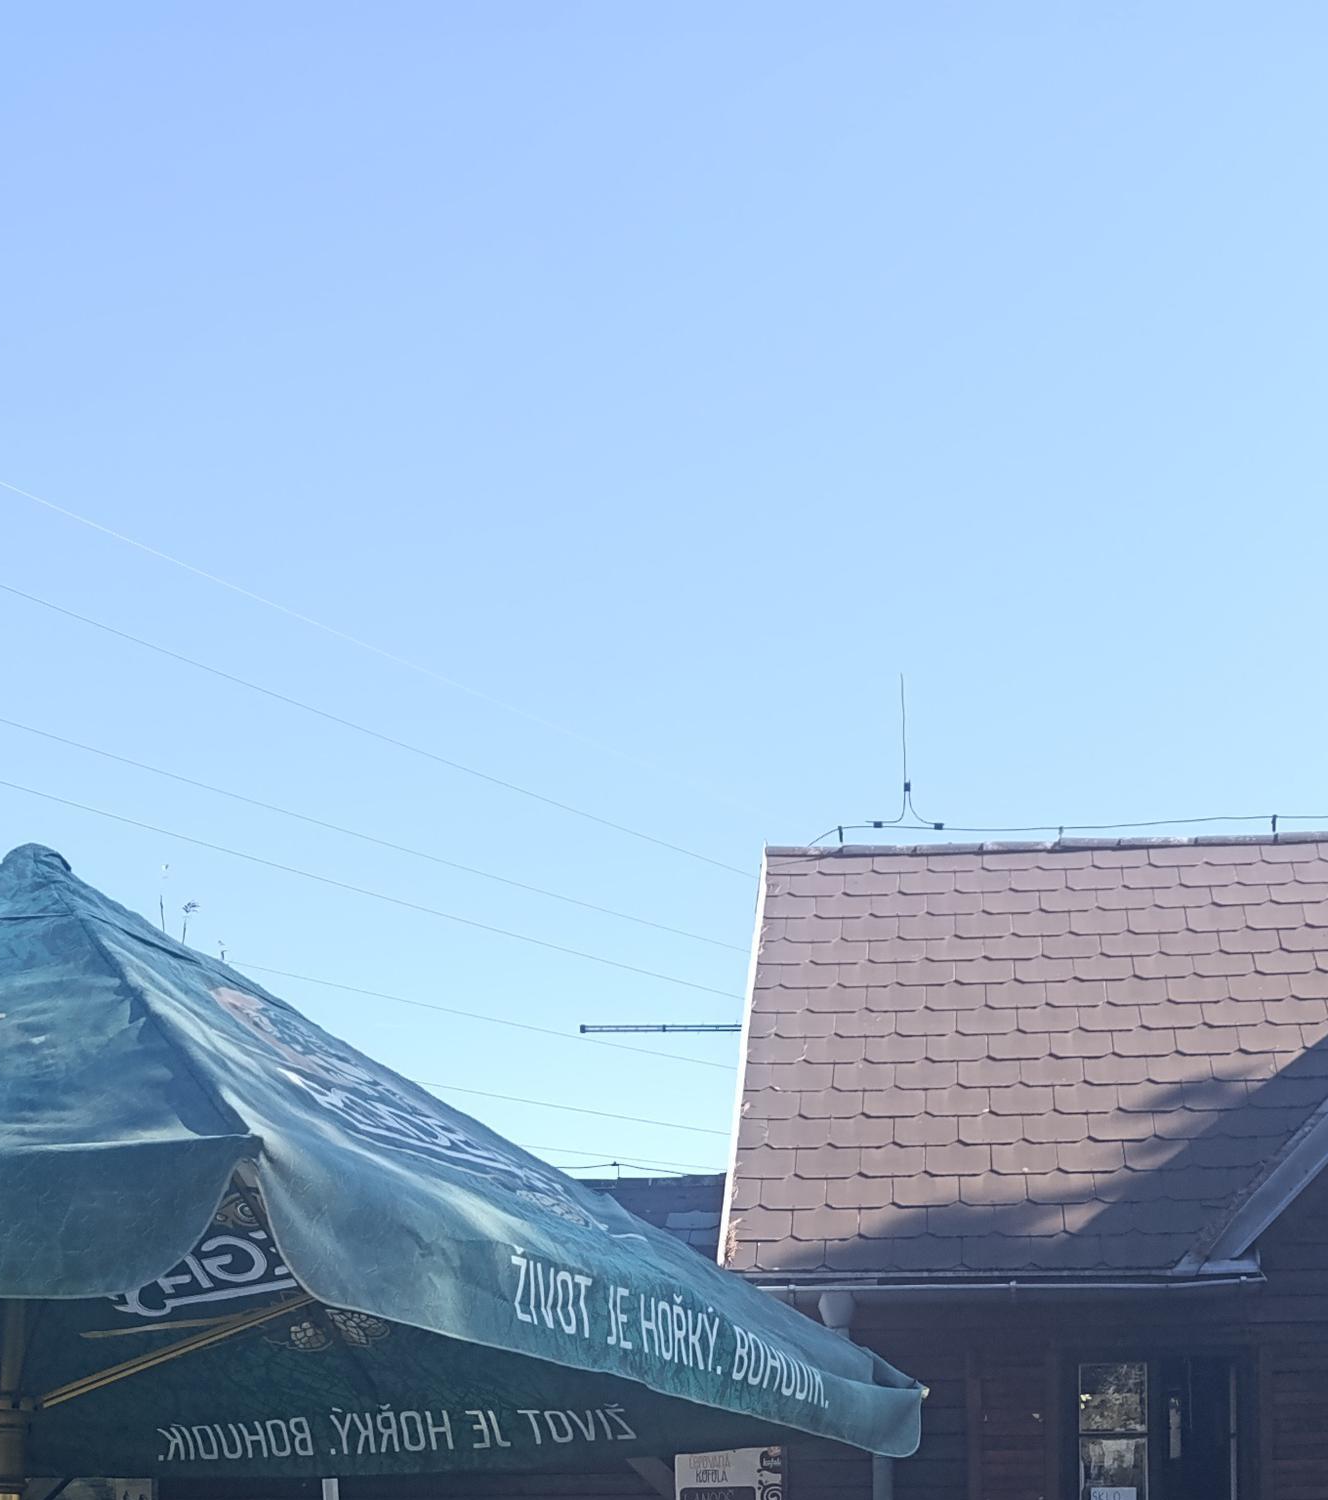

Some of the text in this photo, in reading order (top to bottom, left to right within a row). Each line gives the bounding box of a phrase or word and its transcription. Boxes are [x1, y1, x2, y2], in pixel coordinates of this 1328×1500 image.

[511, 1245, 592, 1338] ŽIVOT
[607, 1285, 632, 1349] JE
[640, 1294, 722, 1375] HOŘKÝ.
[695, 1469, 728, 1483] KOFOLA
